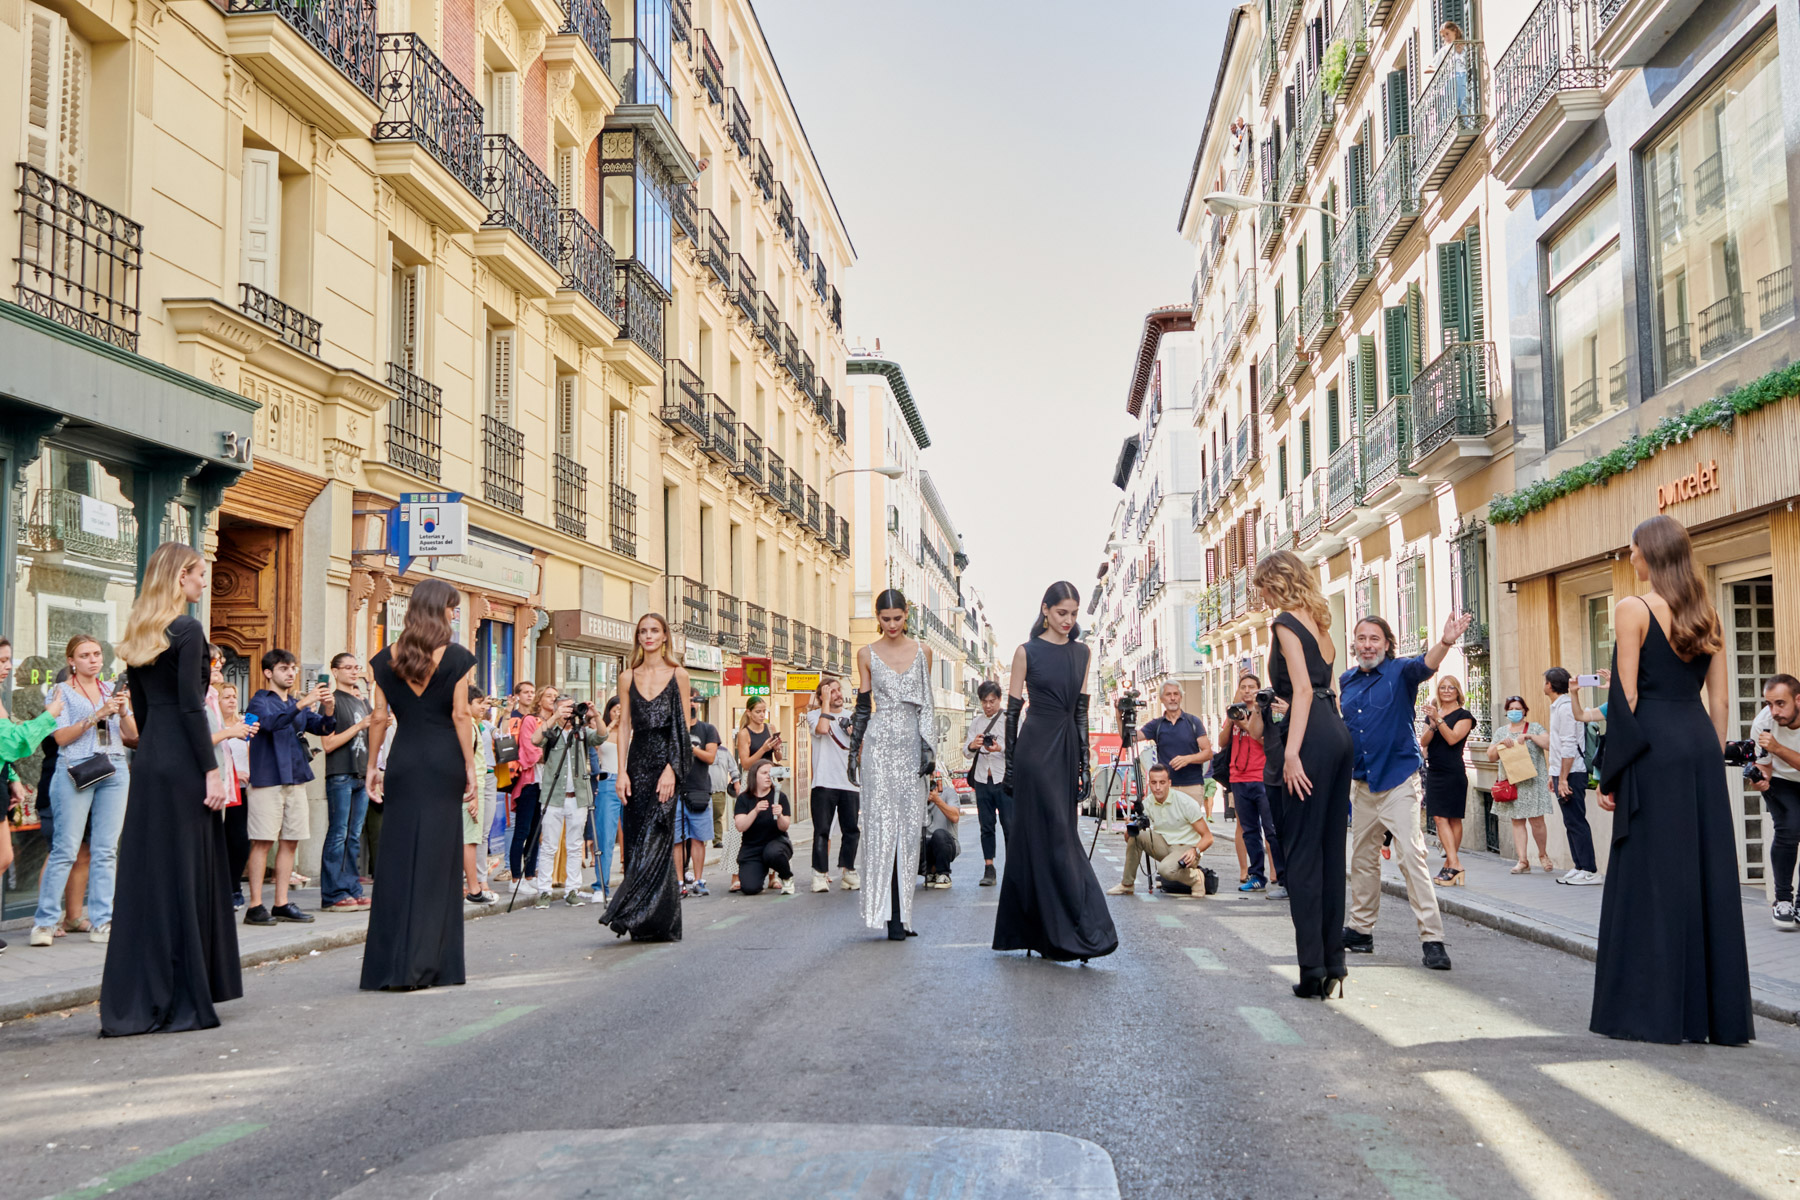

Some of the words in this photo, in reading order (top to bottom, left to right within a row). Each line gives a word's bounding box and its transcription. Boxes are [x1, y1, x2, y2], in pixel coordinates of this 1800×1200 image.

[222, 430, 253, 464] 30
[1657, 459, 1719, 515] poncelet
[588, 616, 633, 642] FERRETERIA
